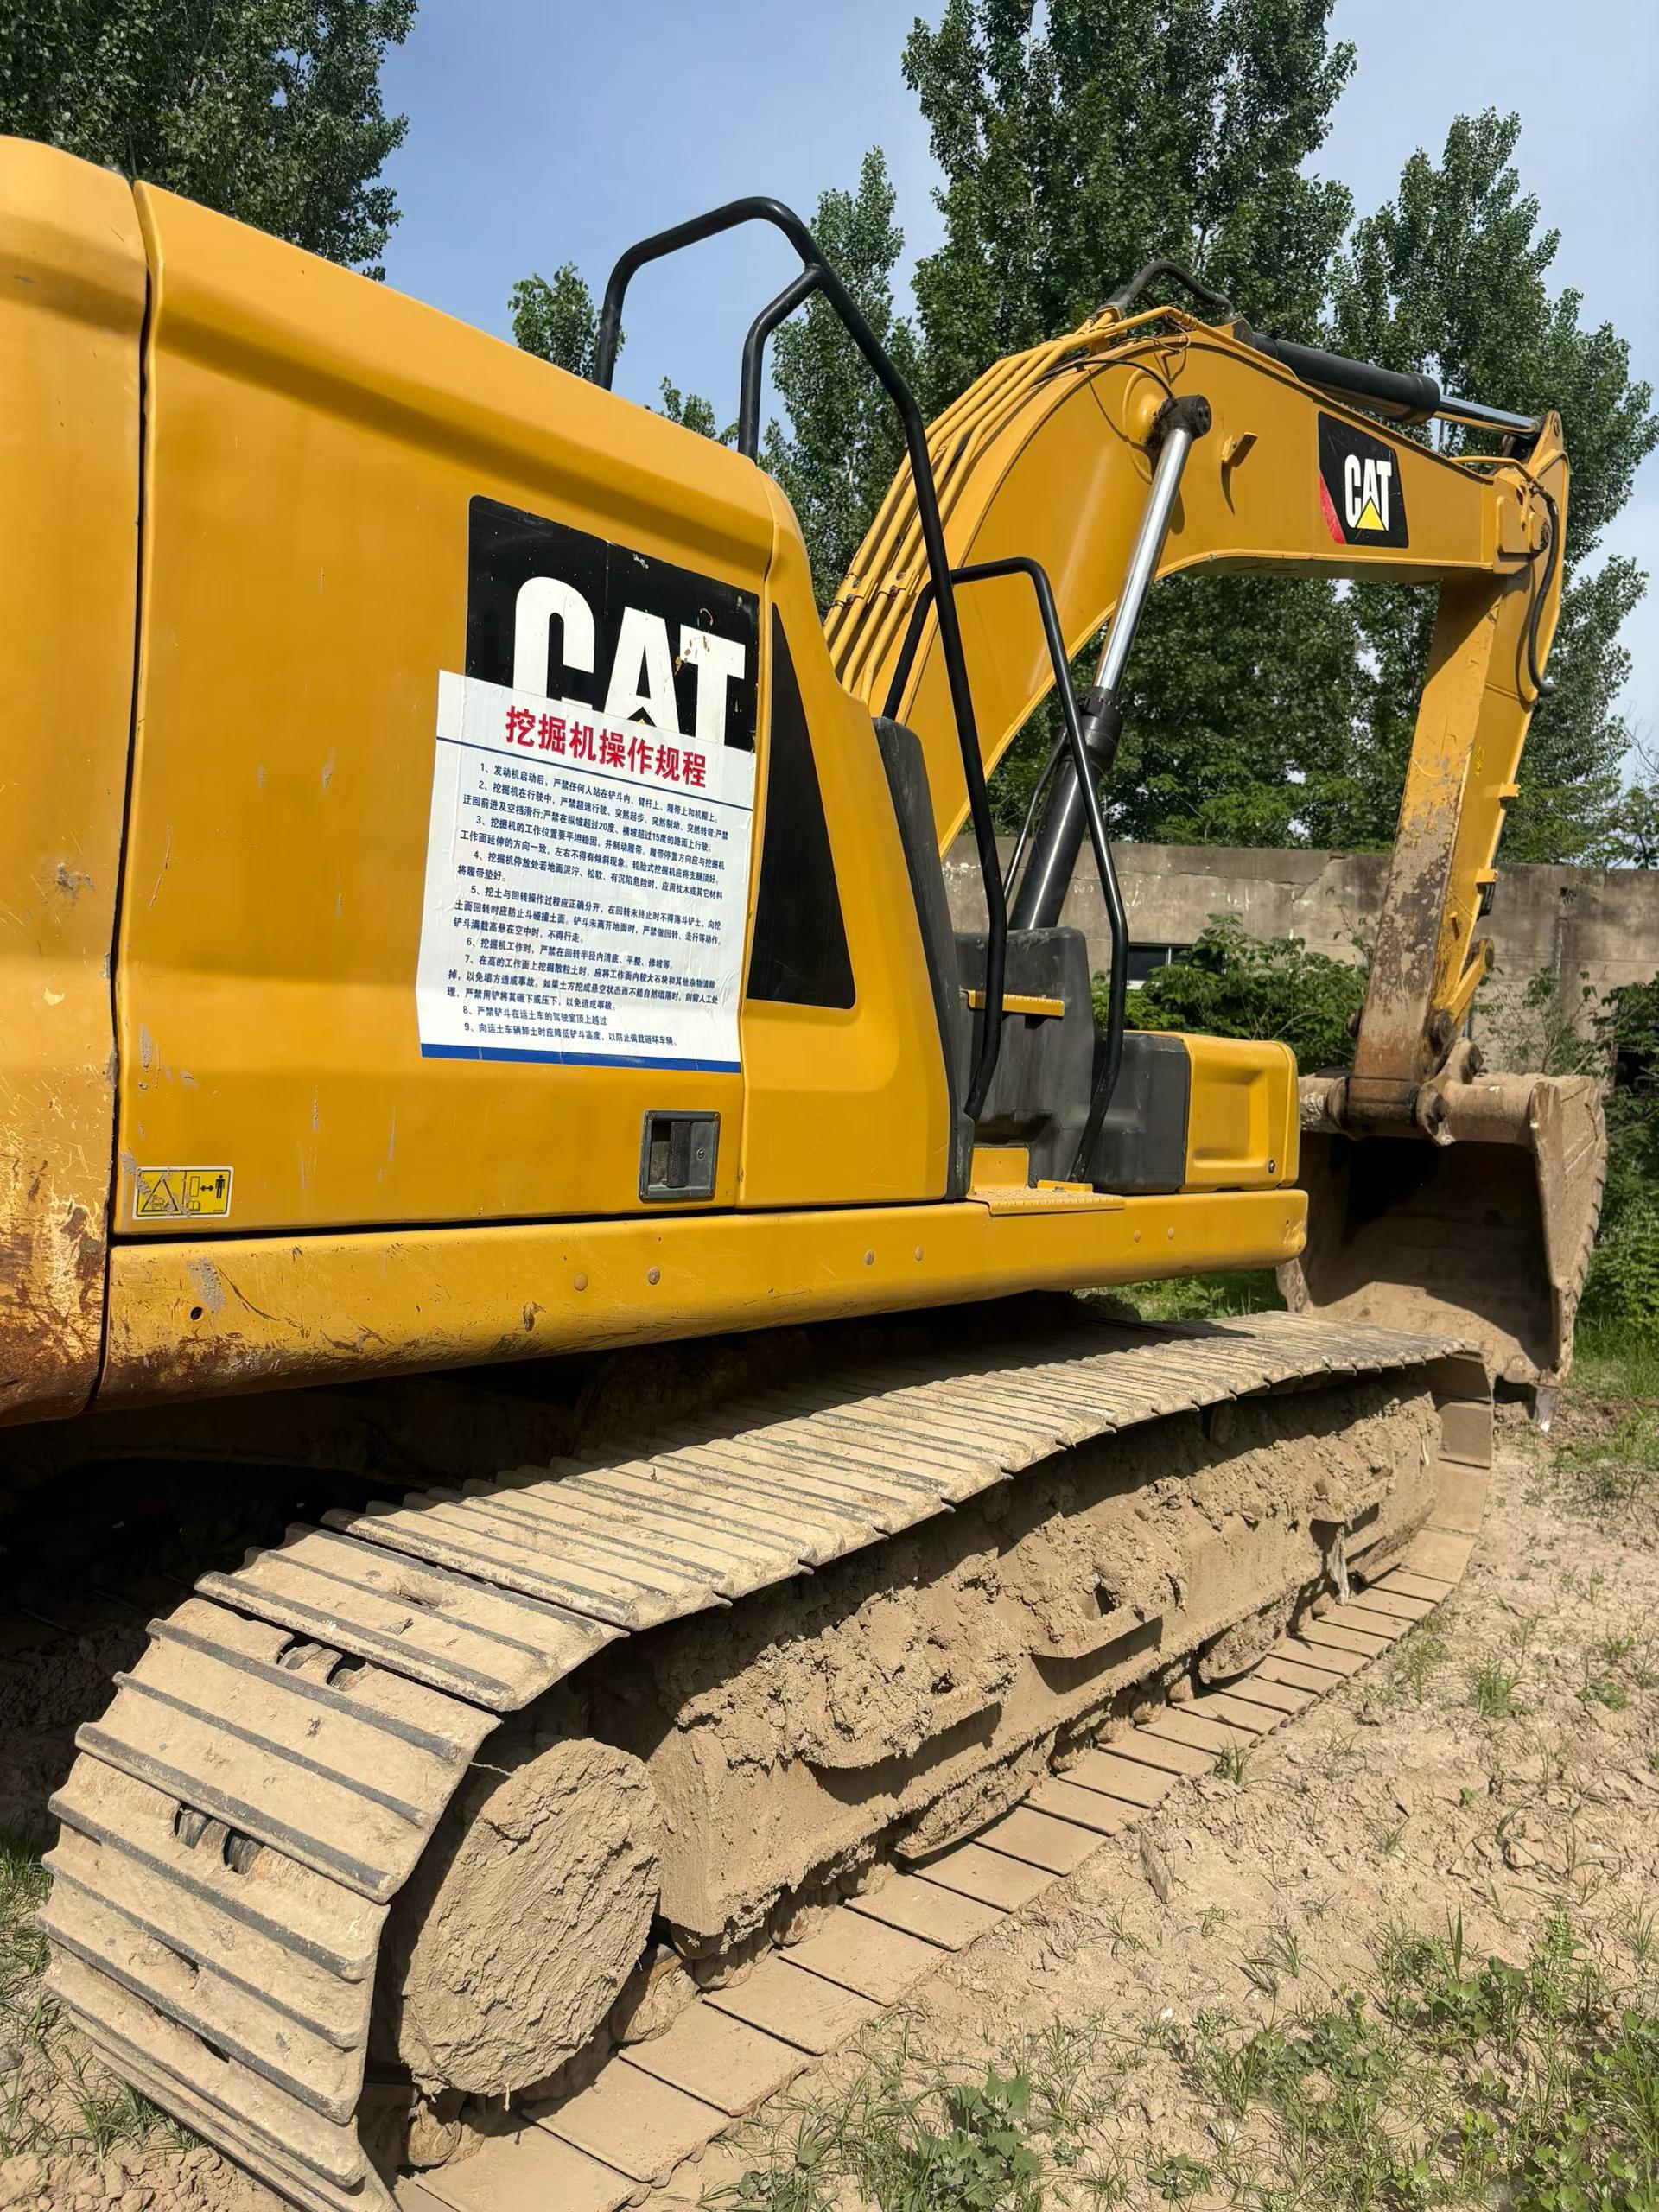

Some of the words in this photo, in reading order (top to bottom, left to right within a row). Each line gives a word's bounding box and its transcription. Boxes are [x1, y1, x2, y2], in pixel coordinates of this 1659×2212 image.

[1344, 454, 1392, 531] CAT
[513, 576, 746, 746] CAT
[505, 704, 706, 787] 挖掘机操作规程
[457, 864, 506, 881] 将履带垫好。
